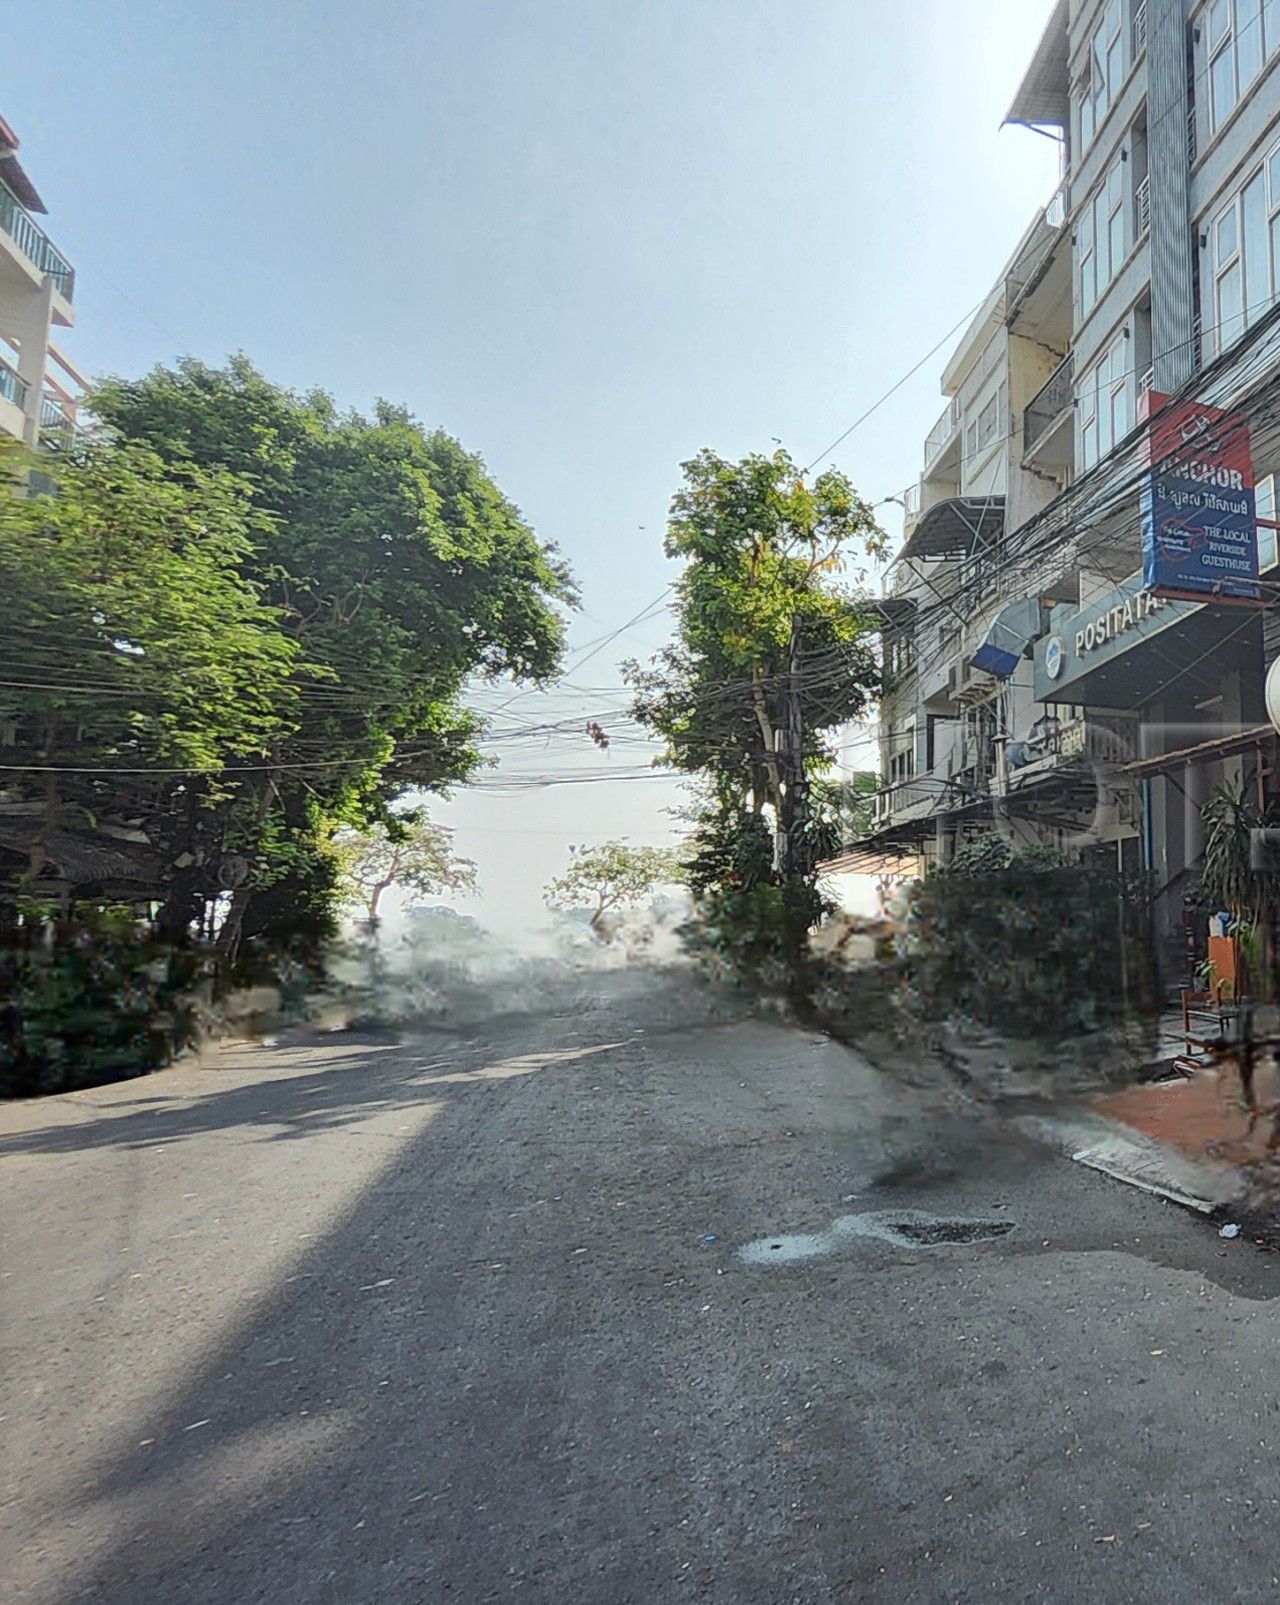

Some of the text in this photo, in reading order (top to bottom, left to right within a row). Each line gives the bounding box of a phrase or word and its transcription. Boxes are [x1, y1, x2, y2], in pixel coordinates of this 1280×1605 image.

[1203, 525, 1251, 543] THE LOCAL
[1209, 541, 1247, 556] RIVERSIDE
